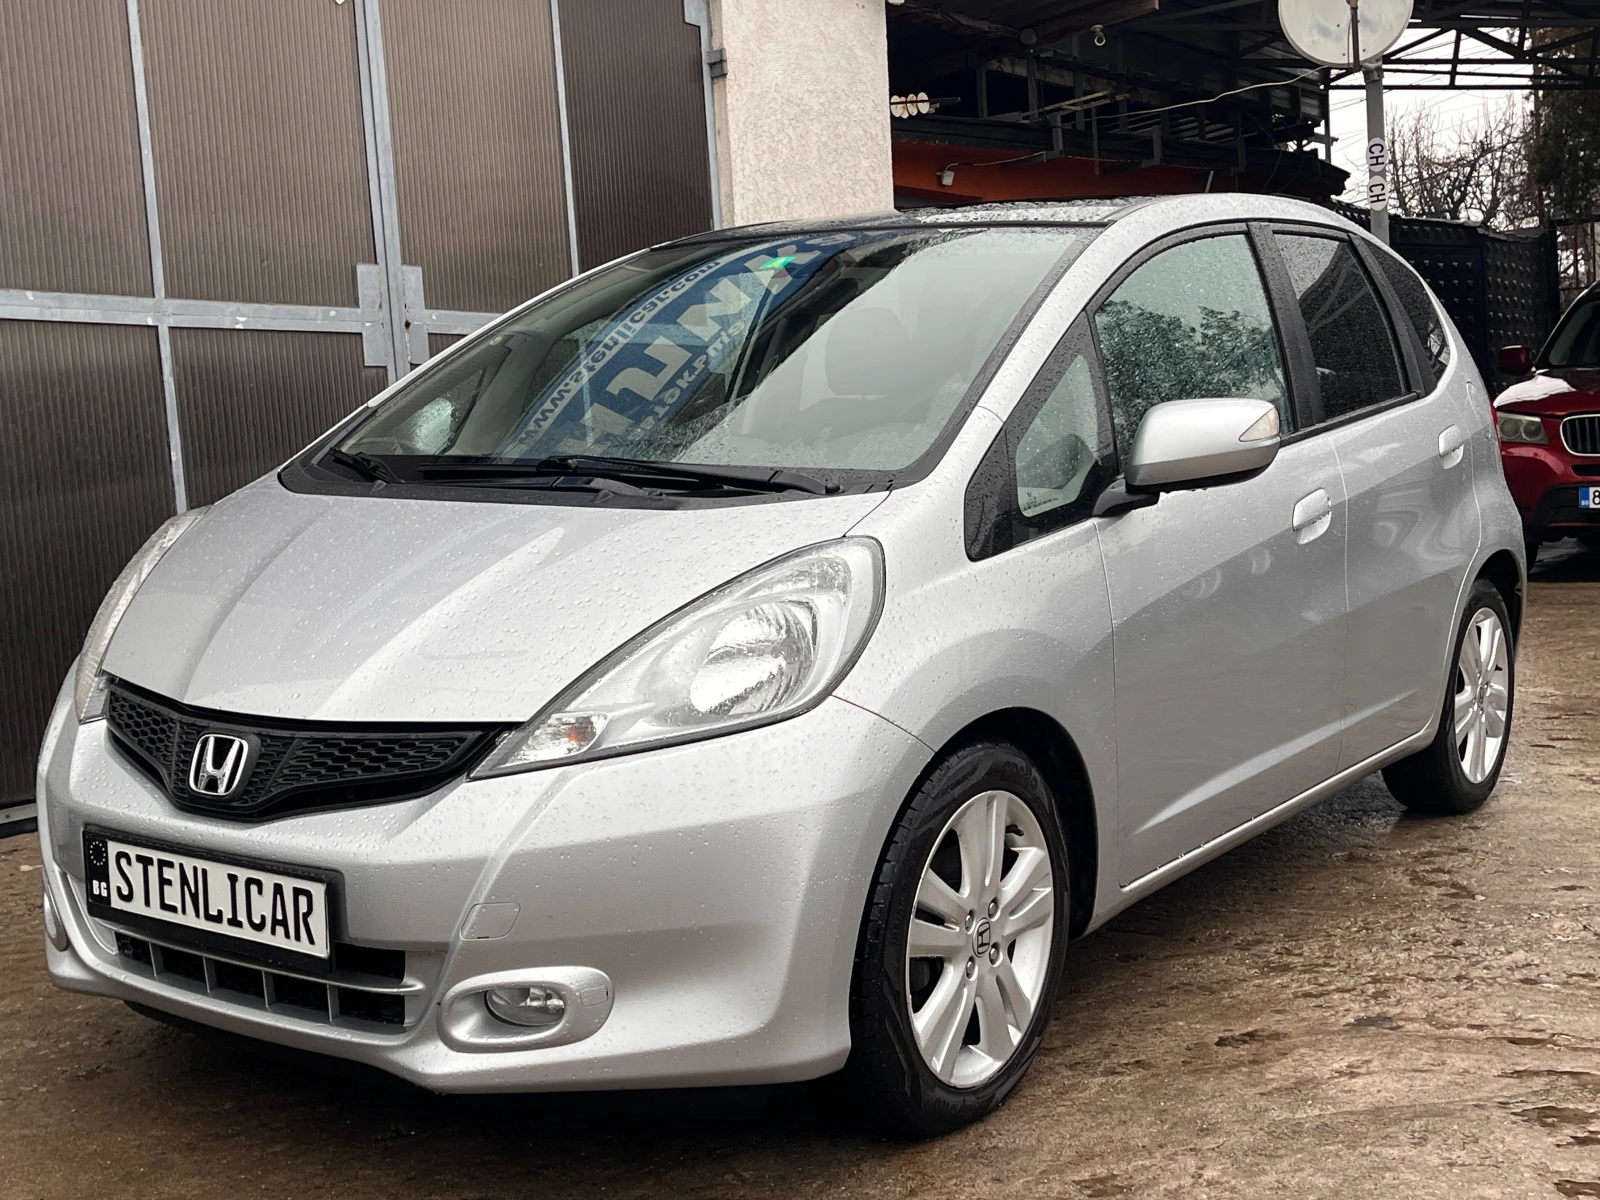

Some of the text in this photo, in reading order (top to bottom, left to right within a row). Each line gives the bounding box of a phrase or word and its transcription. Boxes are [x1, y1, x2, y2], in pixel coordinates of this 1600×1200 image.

[1369, 143, 1385, 166] CH
[1369, 183, 1386, 203] CH
[92, 879, 109, 898] BG
[115, 850, 316, 946] STENLICAR
